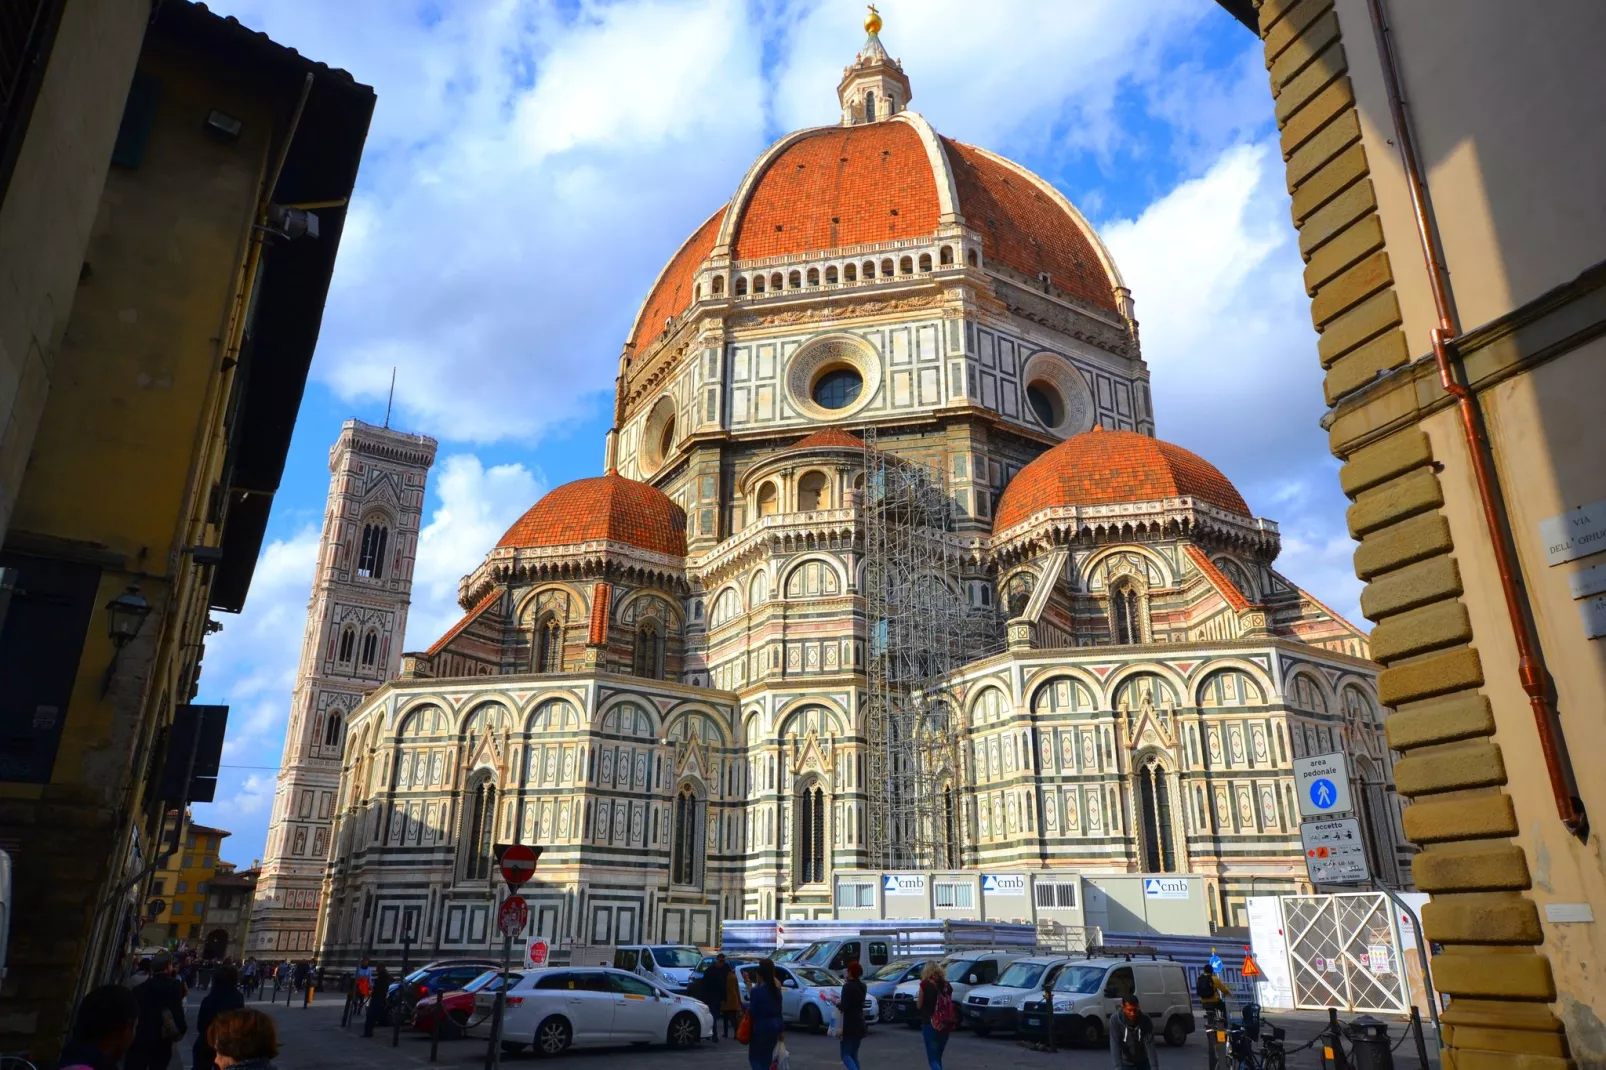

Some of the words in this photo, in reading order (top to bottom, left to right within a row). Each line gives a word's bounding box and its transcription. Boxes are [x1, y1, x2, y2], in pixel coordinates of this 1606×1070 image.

[1573, 515, 1591, 526] VIA
[1310, 759, 1327, 767] area
[1303, 767, 1337, 779] pedonale
[1315, 821, 1343, 831] eccetto
[898, 876, 924, 888] cmb
[997, 876, 1024, 888] cmb
[1160, 880, 1188, 892] cmb
